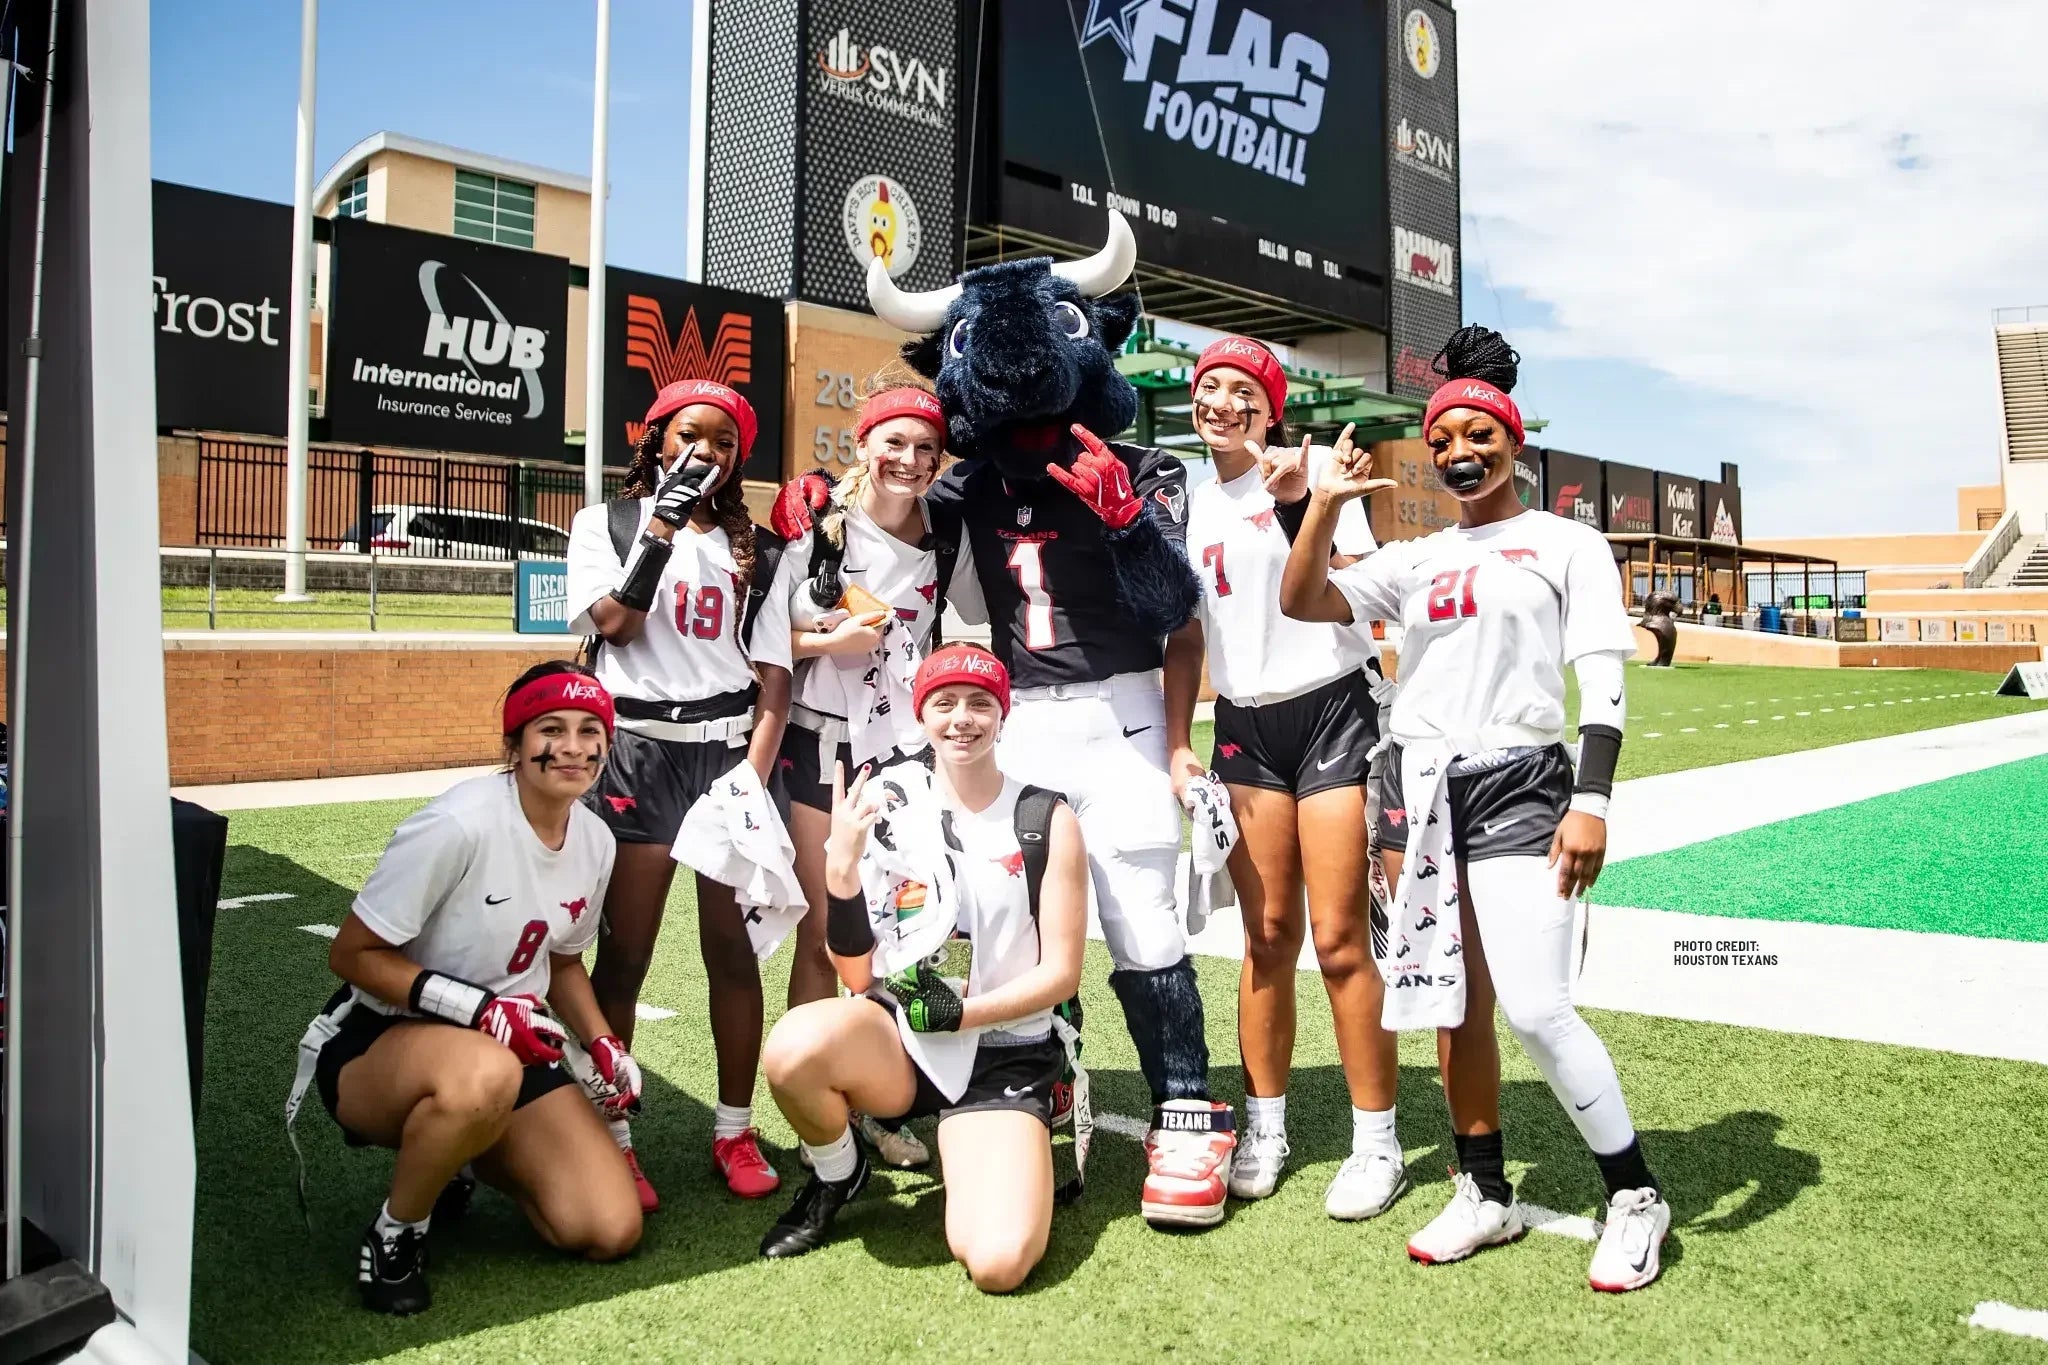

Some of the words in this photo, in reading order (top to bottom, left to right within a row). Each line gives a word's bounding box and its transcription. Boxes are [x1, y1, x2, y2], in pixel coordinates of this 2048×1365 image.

[869, 45, 946, 109] SVN
[1122, 0, 1330, 135] FLAG
[820, 72, 865, 105] VERUS
[865, 88, 944, 129] COMMERCIAL
[1143, 80, 1307, 187] FOOTBALL
[1415, 128, 1453, 170] SVN
[1106, 191, 1140, 218] DOWN
[1145, 203, 1161, 224] TO
[1161, 208, 1178, 229] GO
[1394, 225, 1454, 286] RHINO
[423, 312, 546, 369] HUB
[352, 357, 521, 400] International
[815, 369, 855, 409] 28
[377, 394, 450, 418] Insurance
[455, 402, 512, 425] Services
[814, 425, 856, 465] 55
[1667, 484, 1695, 511] Kwik
[530, 573, 568, 600] DISCO
[1006, 540, 1056, 651] 1
[1203, 542, 1232, 598] 7
[1427, 564, 1480, 623] 21
[674, 580, 724, 640] 19
[507, 919, 549, 975] 8
[1162, 1111, 1212, 1130] TEXANS
